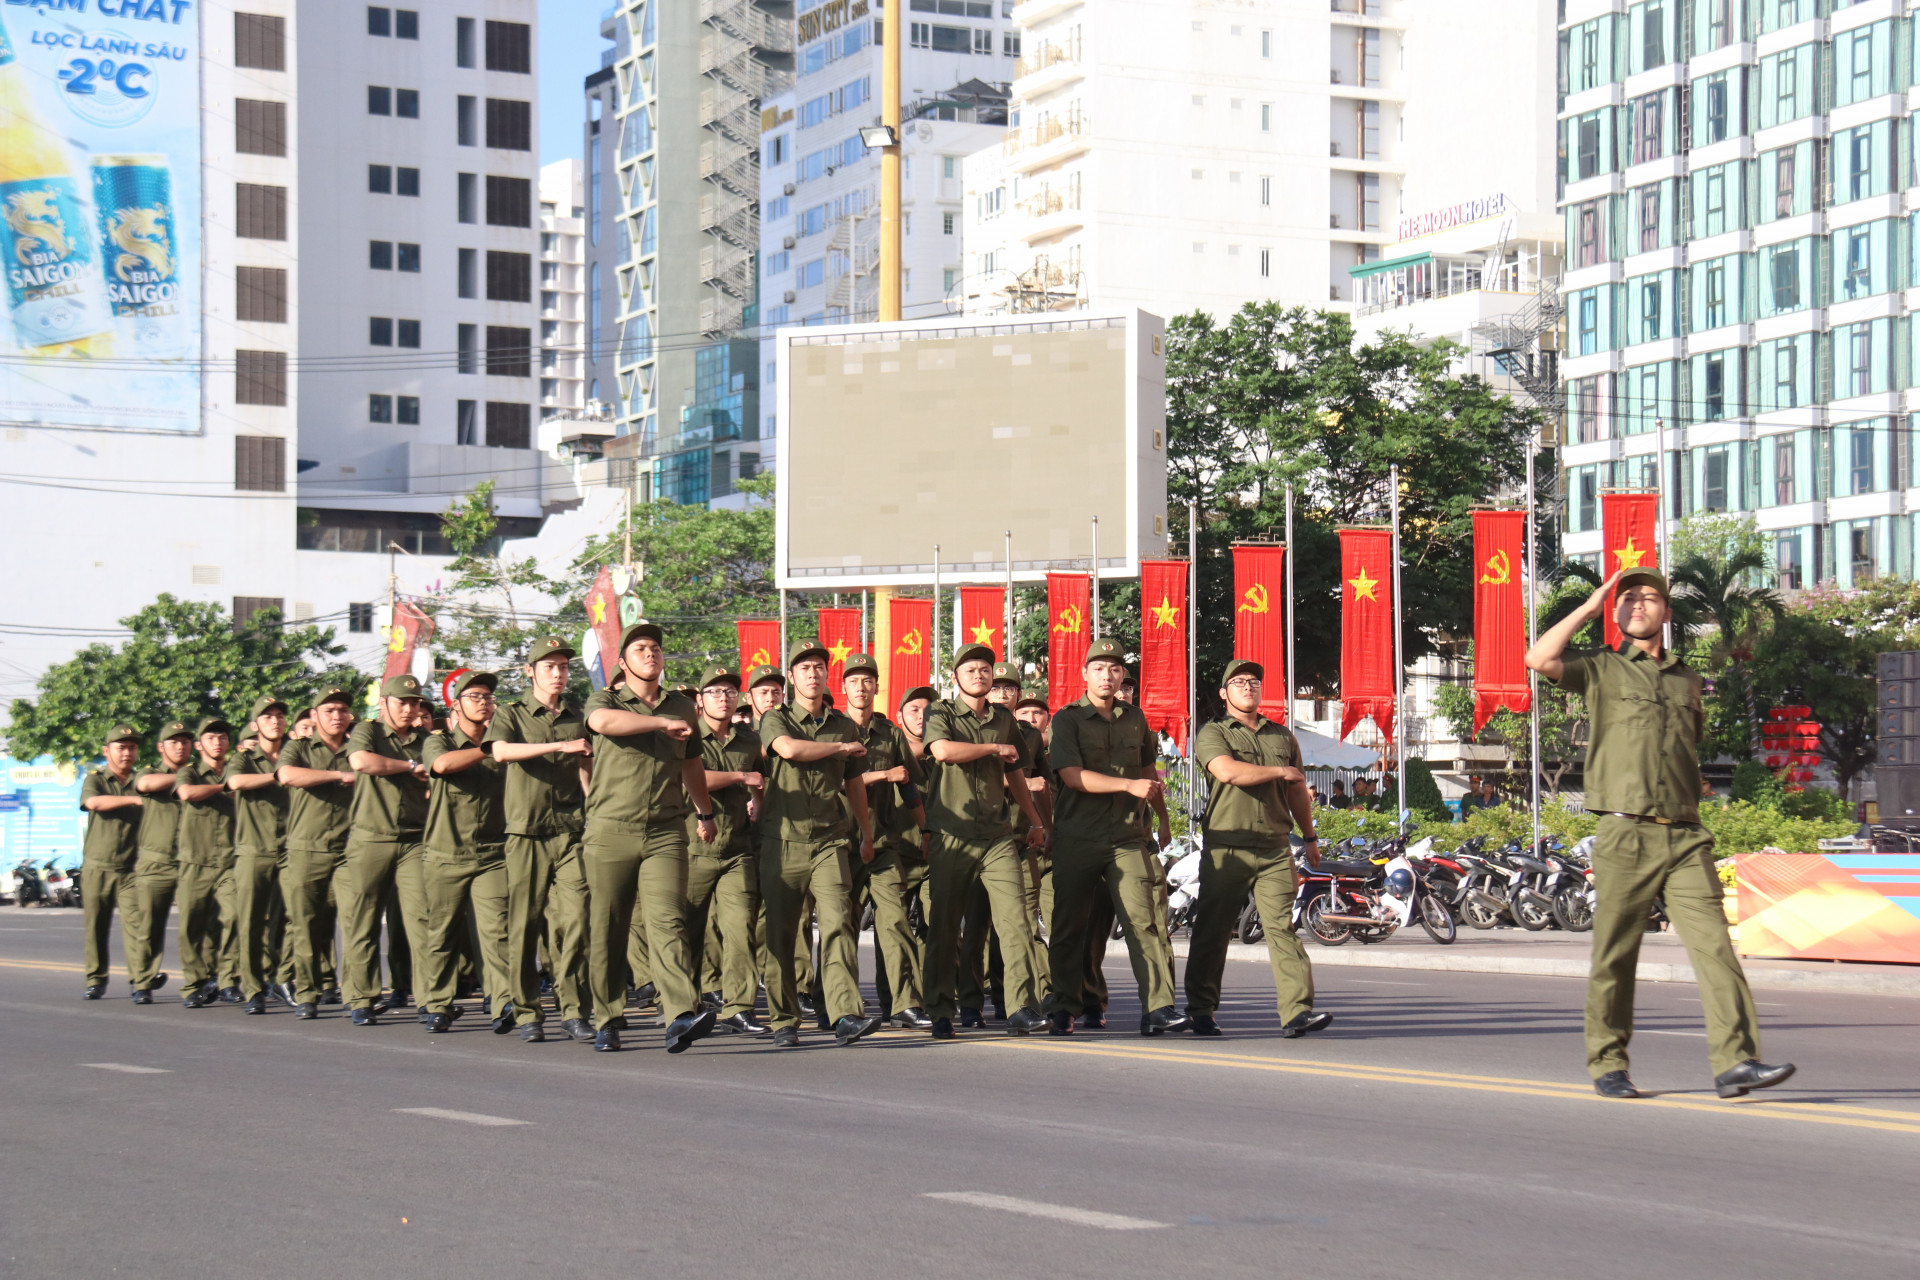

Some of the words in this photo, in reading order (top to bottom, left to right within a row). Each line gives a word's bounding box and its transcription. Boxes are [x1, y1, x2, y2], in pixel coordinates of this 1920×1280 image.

[797, 7, 822, 47] SUN
[821, 0, 850, 34] CITY
[1423, 203, 1463, 234] MOON
[1465, 192, 1507, 223] HOTEL
[32, 252, 60, 266] BIA
[130, 271, 161, 284] BIA
